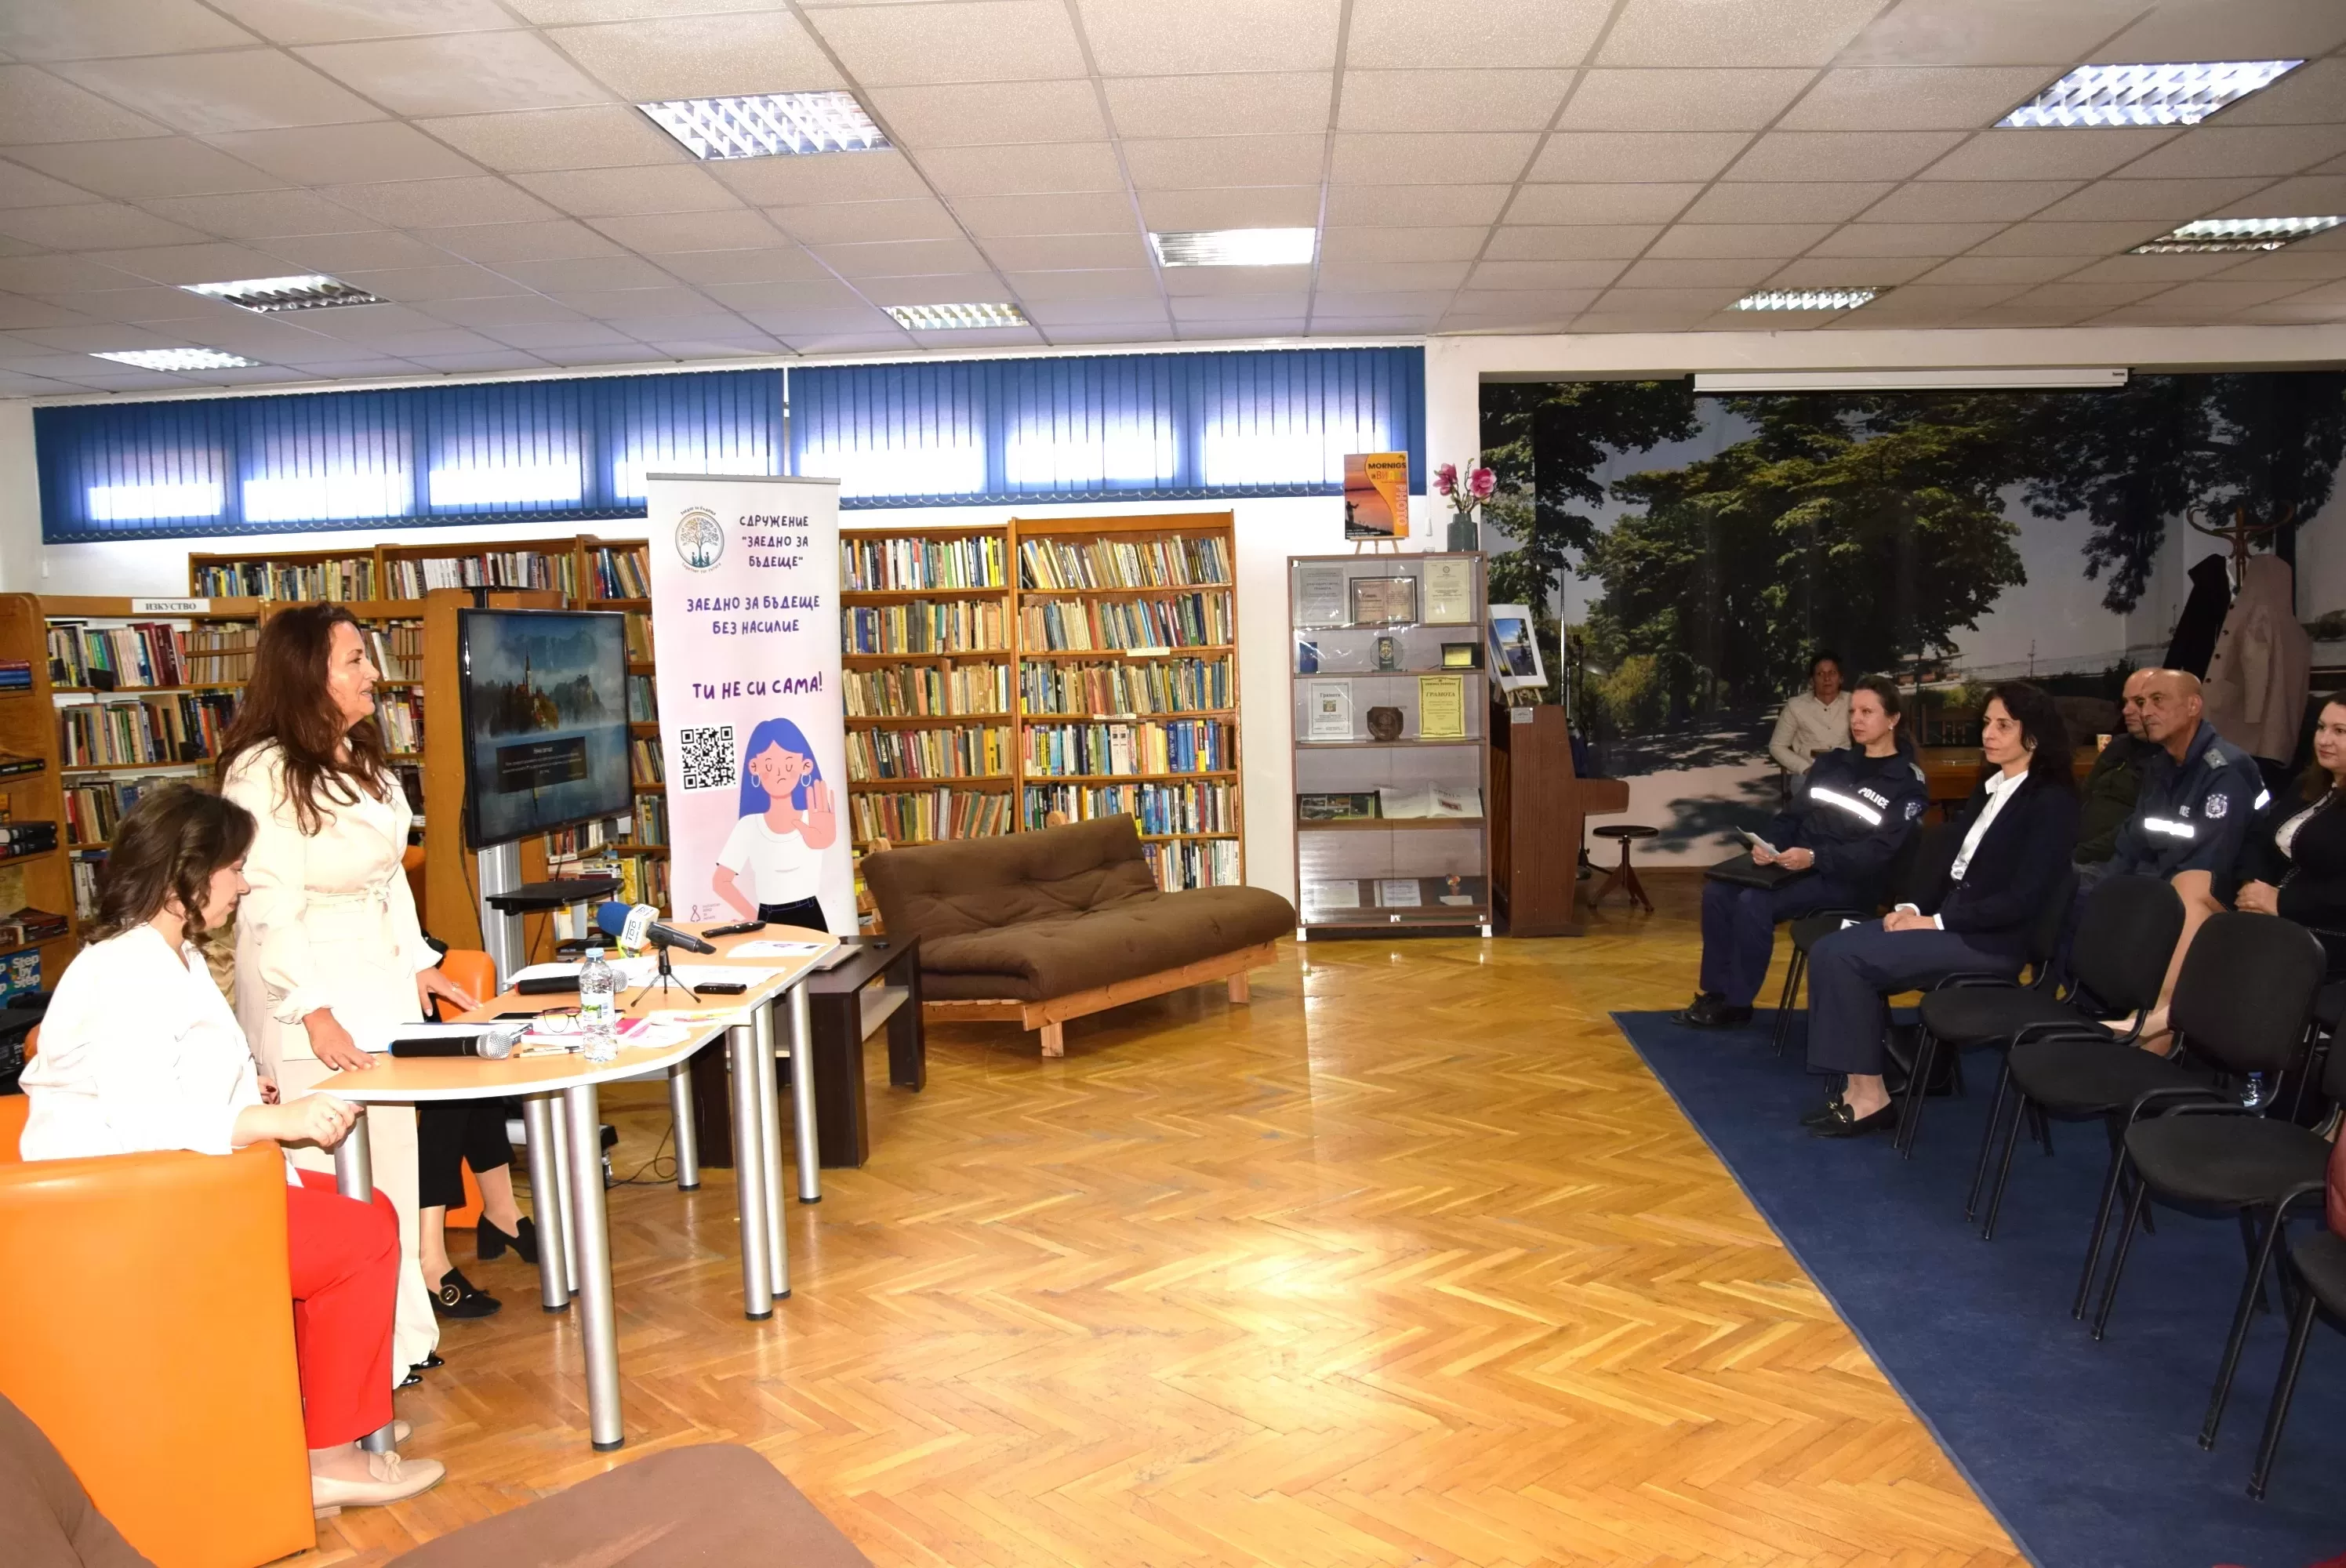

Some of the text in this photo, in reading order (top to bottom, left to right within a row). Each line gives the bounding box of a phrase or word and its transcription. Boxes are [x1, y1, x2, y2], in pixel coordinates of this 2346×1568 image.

[1396, 485, 1407, 526] PHOTO
[739, 514, 809, 528] СДРУЖЕНИЕ
[796, 535, 808, 548] ЗА
[687, 595, 820, 612] ЗАЕДНО ЗА БЪДЕЩЕ
[712, 619, 800, 635] БЕЗ НАСИЛИЕ
[692, 671, 823, 700] ТИ НЕ СИ САМА!
[1858, 787, 1890, 810] POLICE
[13, 955, 40, 969] Step
[18, 965, 33, 978] by
